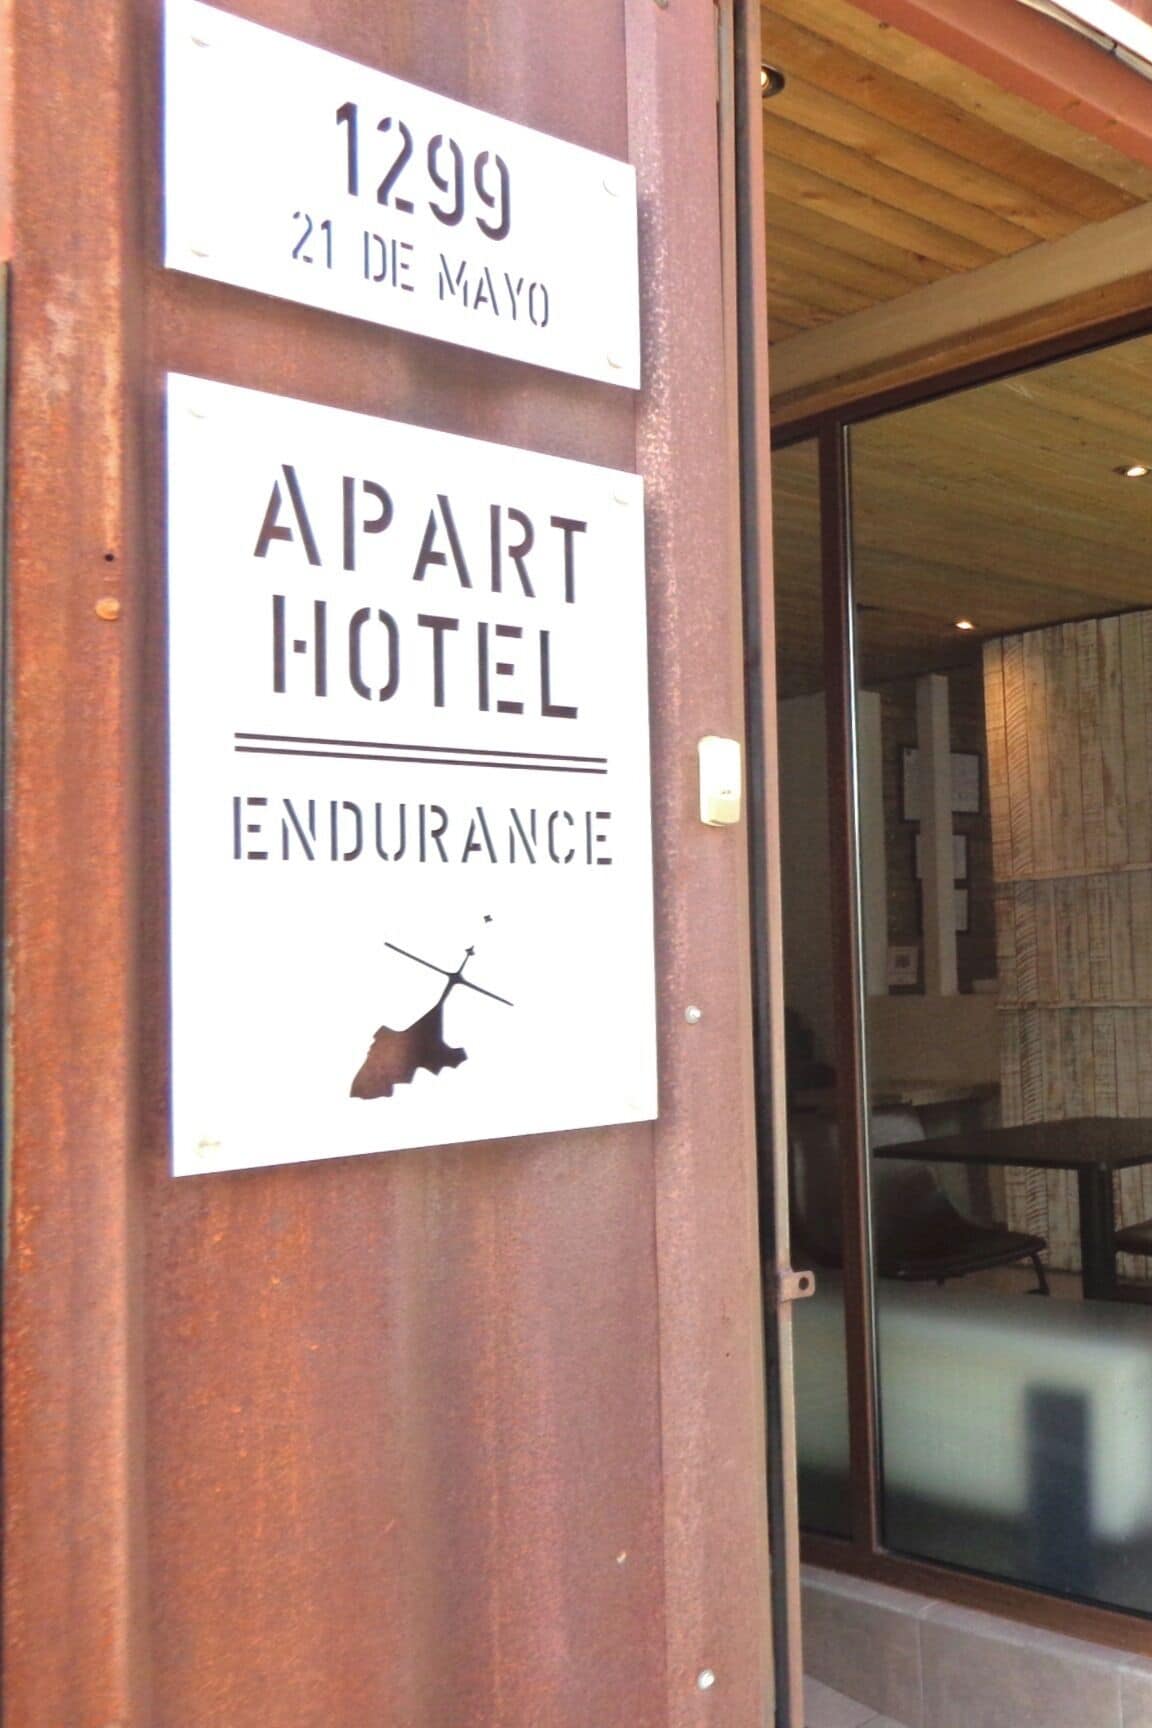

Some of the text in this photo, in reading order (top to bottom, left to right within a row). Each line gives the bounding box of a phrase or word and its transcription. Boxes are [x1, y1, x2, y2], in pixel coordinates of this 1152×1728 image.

[335, 101, 512, 242] 1299
[291, 211, 550, 329] 21 DE MAYO
[252, 463, 588, 604] APART
[272, 594, 579, 721] HOTEL
[232, 795, 614, 867] ENDURANCE
